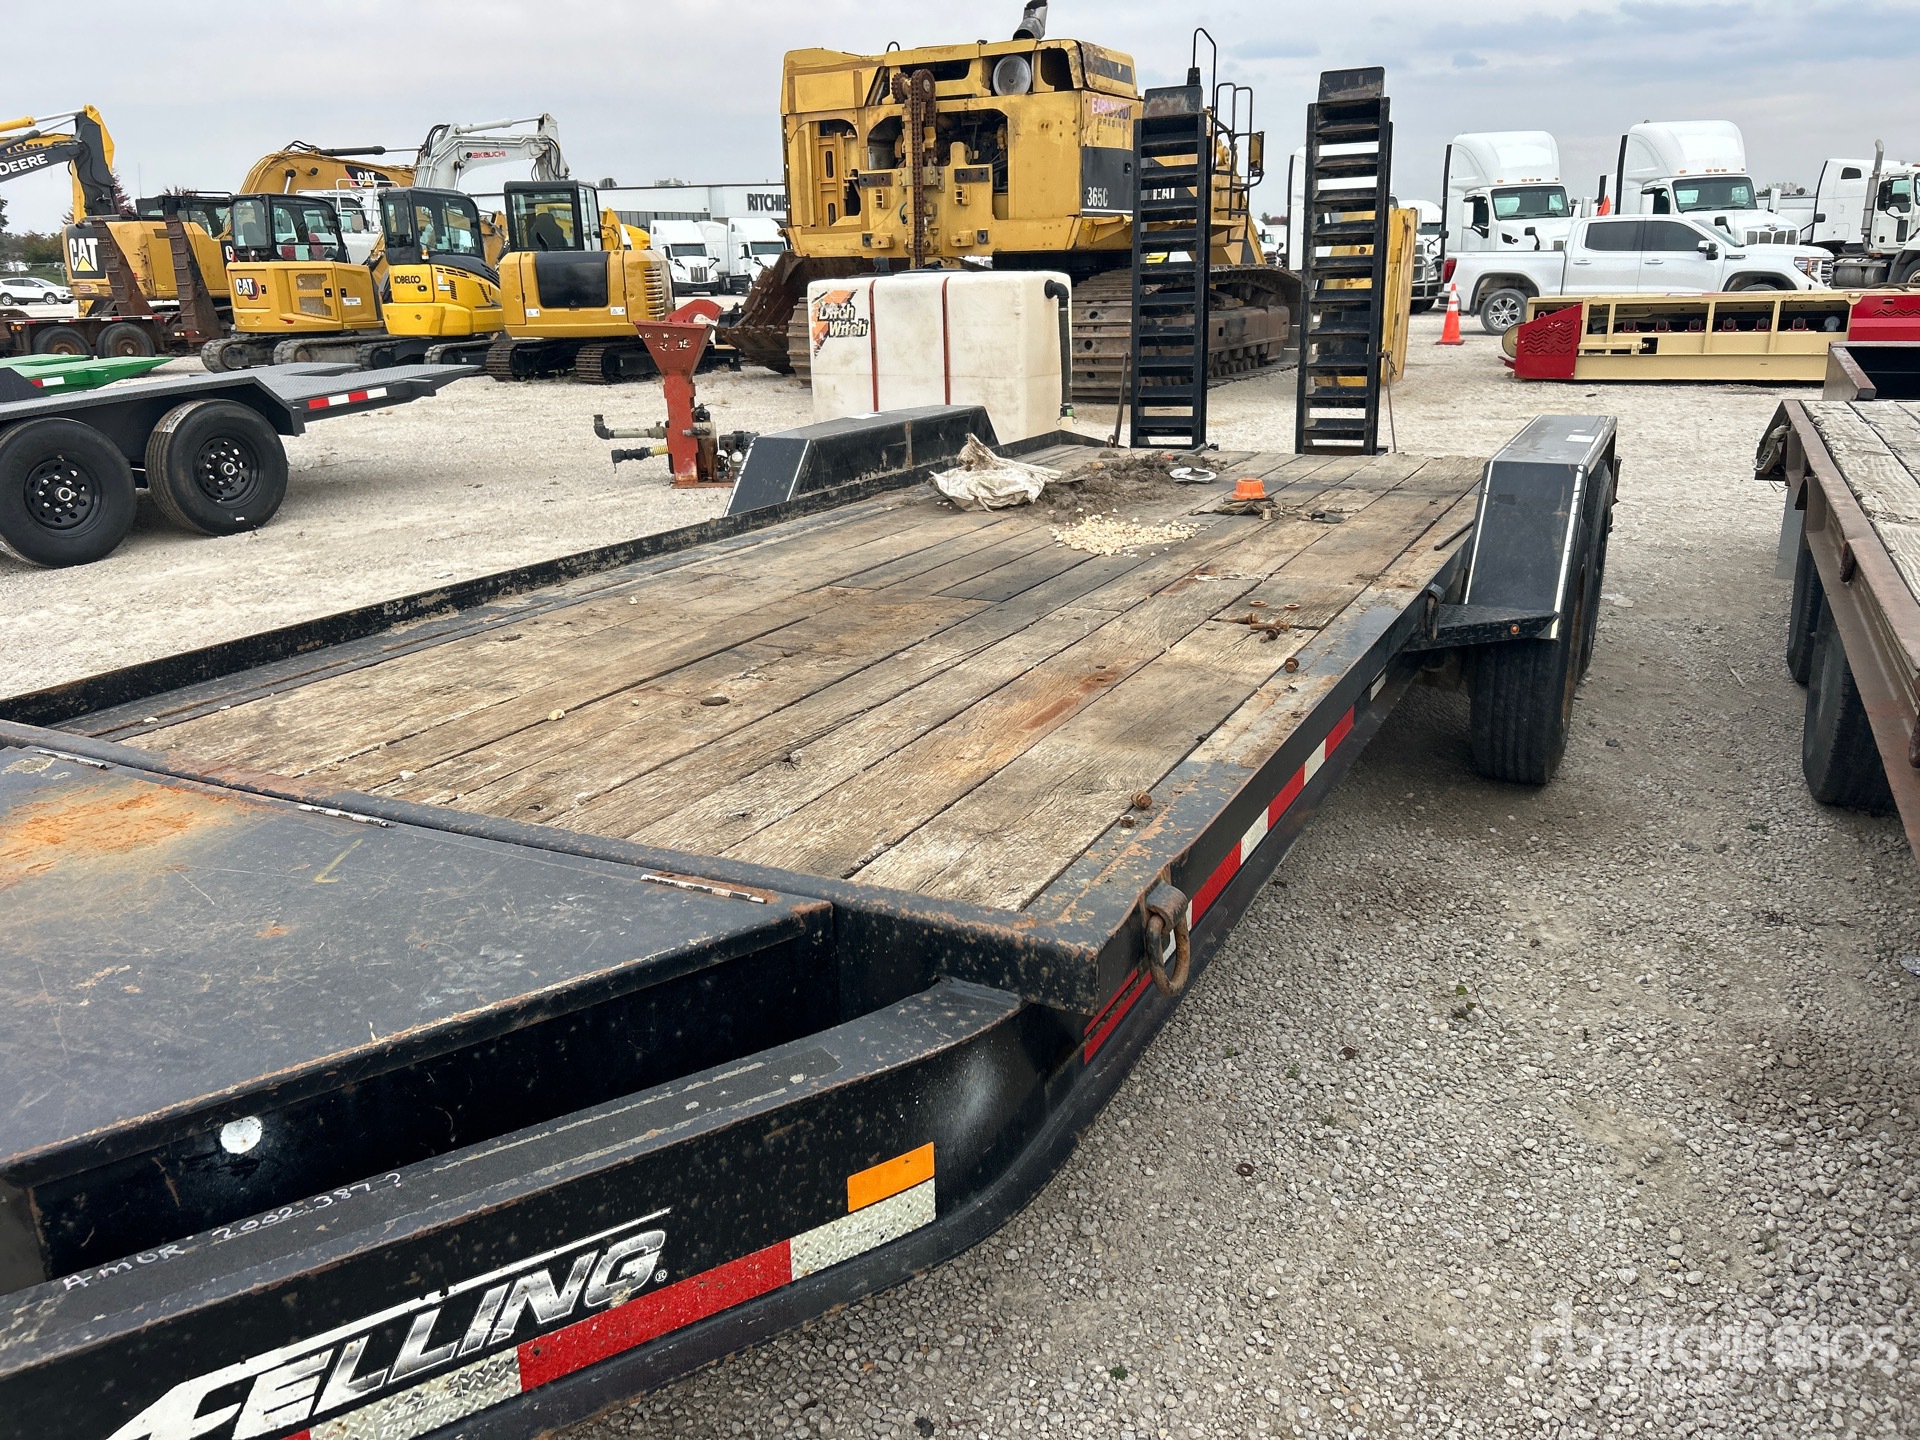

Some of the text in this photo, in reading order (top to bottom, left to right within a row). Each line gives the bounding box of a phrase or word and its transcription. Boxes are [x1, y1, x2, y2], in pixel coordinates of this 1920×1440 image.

[0, 153, 48, 176] DEERE
[357, 171, 377, 187] CAT
[1087, 187, 1108, 207] 365C
[69, 237, 98, 272] CAT
[236, 278, 253, 295] CAT
[394, 274, 421, 284] KOBELCO
[818, 302, 855, 320] Ditch
[829, 319, 868, 337] Witch
[105, 1208, 671, 1440] FELLING
